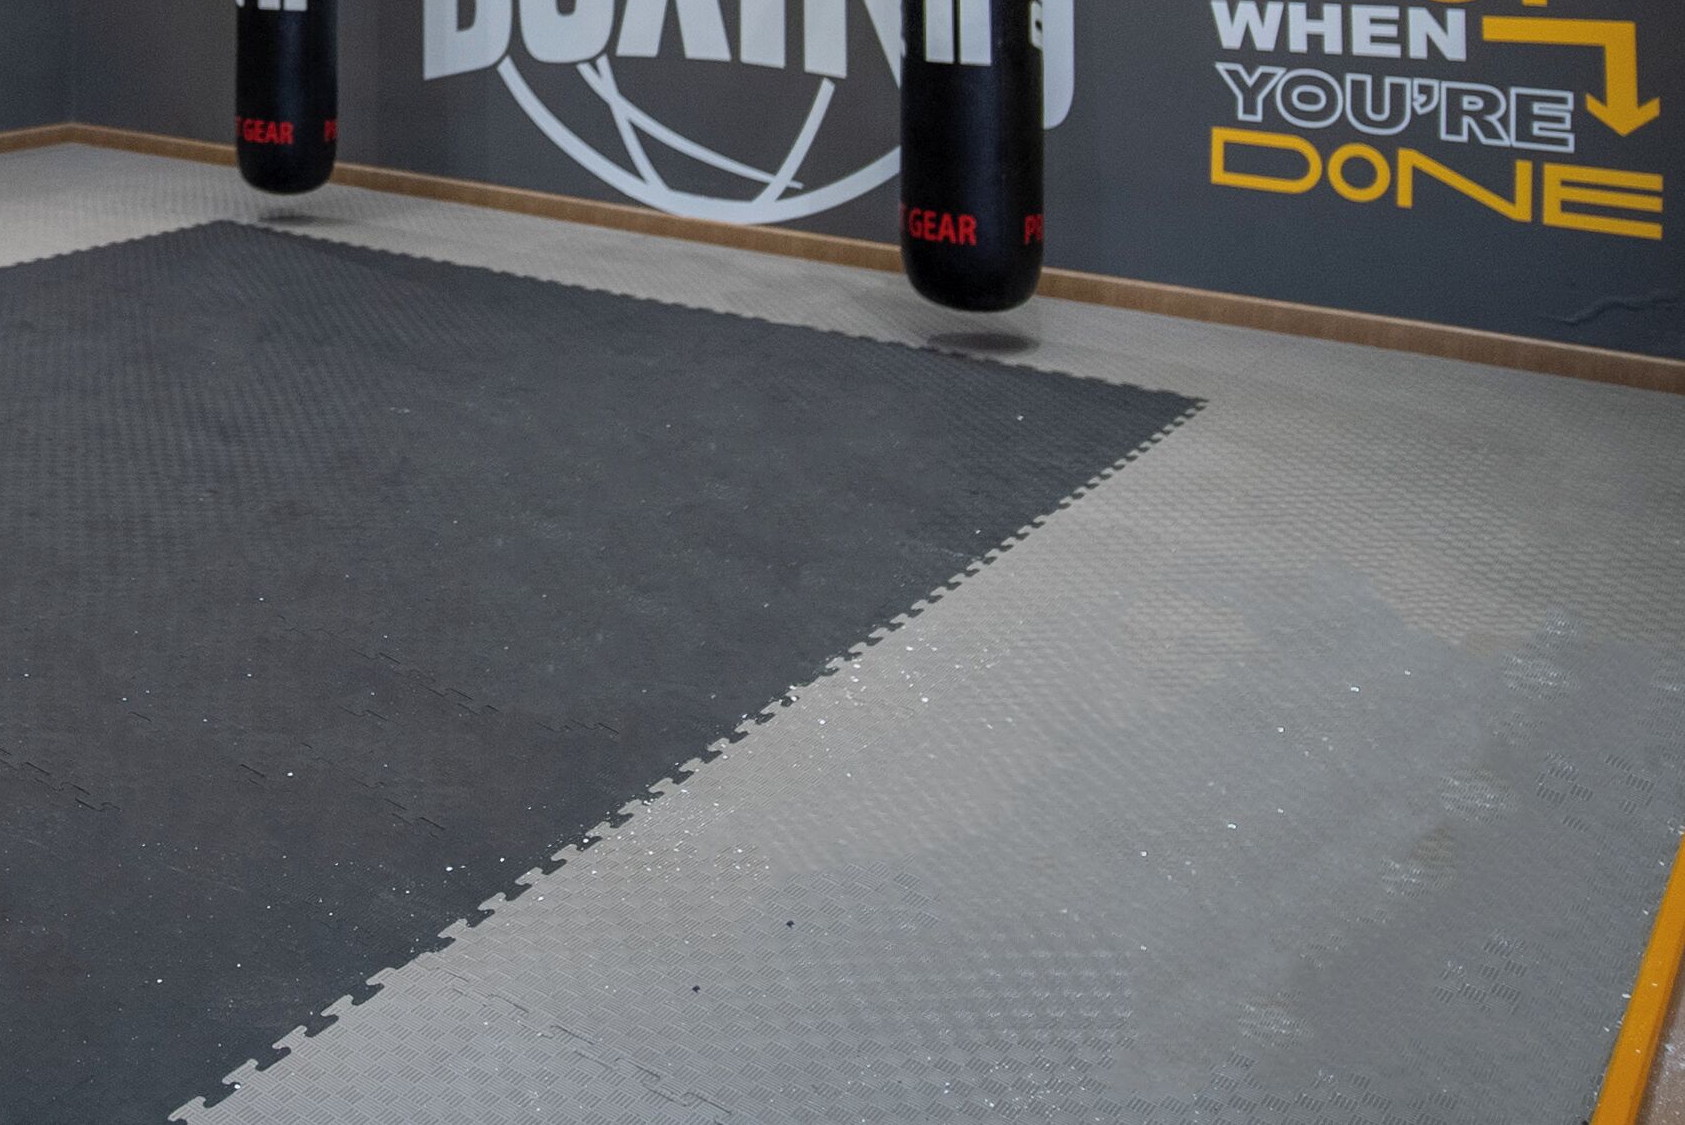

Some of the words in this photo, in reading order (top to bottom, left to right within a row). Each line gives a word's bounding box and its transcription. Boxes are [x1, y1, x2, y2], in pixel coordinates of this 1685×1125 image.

[1210, 0, 1467, 61] WHEN
[243, 119, 294, 145] GEAR
[1215, 62, 1575, 153] YOU'RE
[1211, 126, 1663, 240] DONE
[908, 207, 978, 246] GEAR
